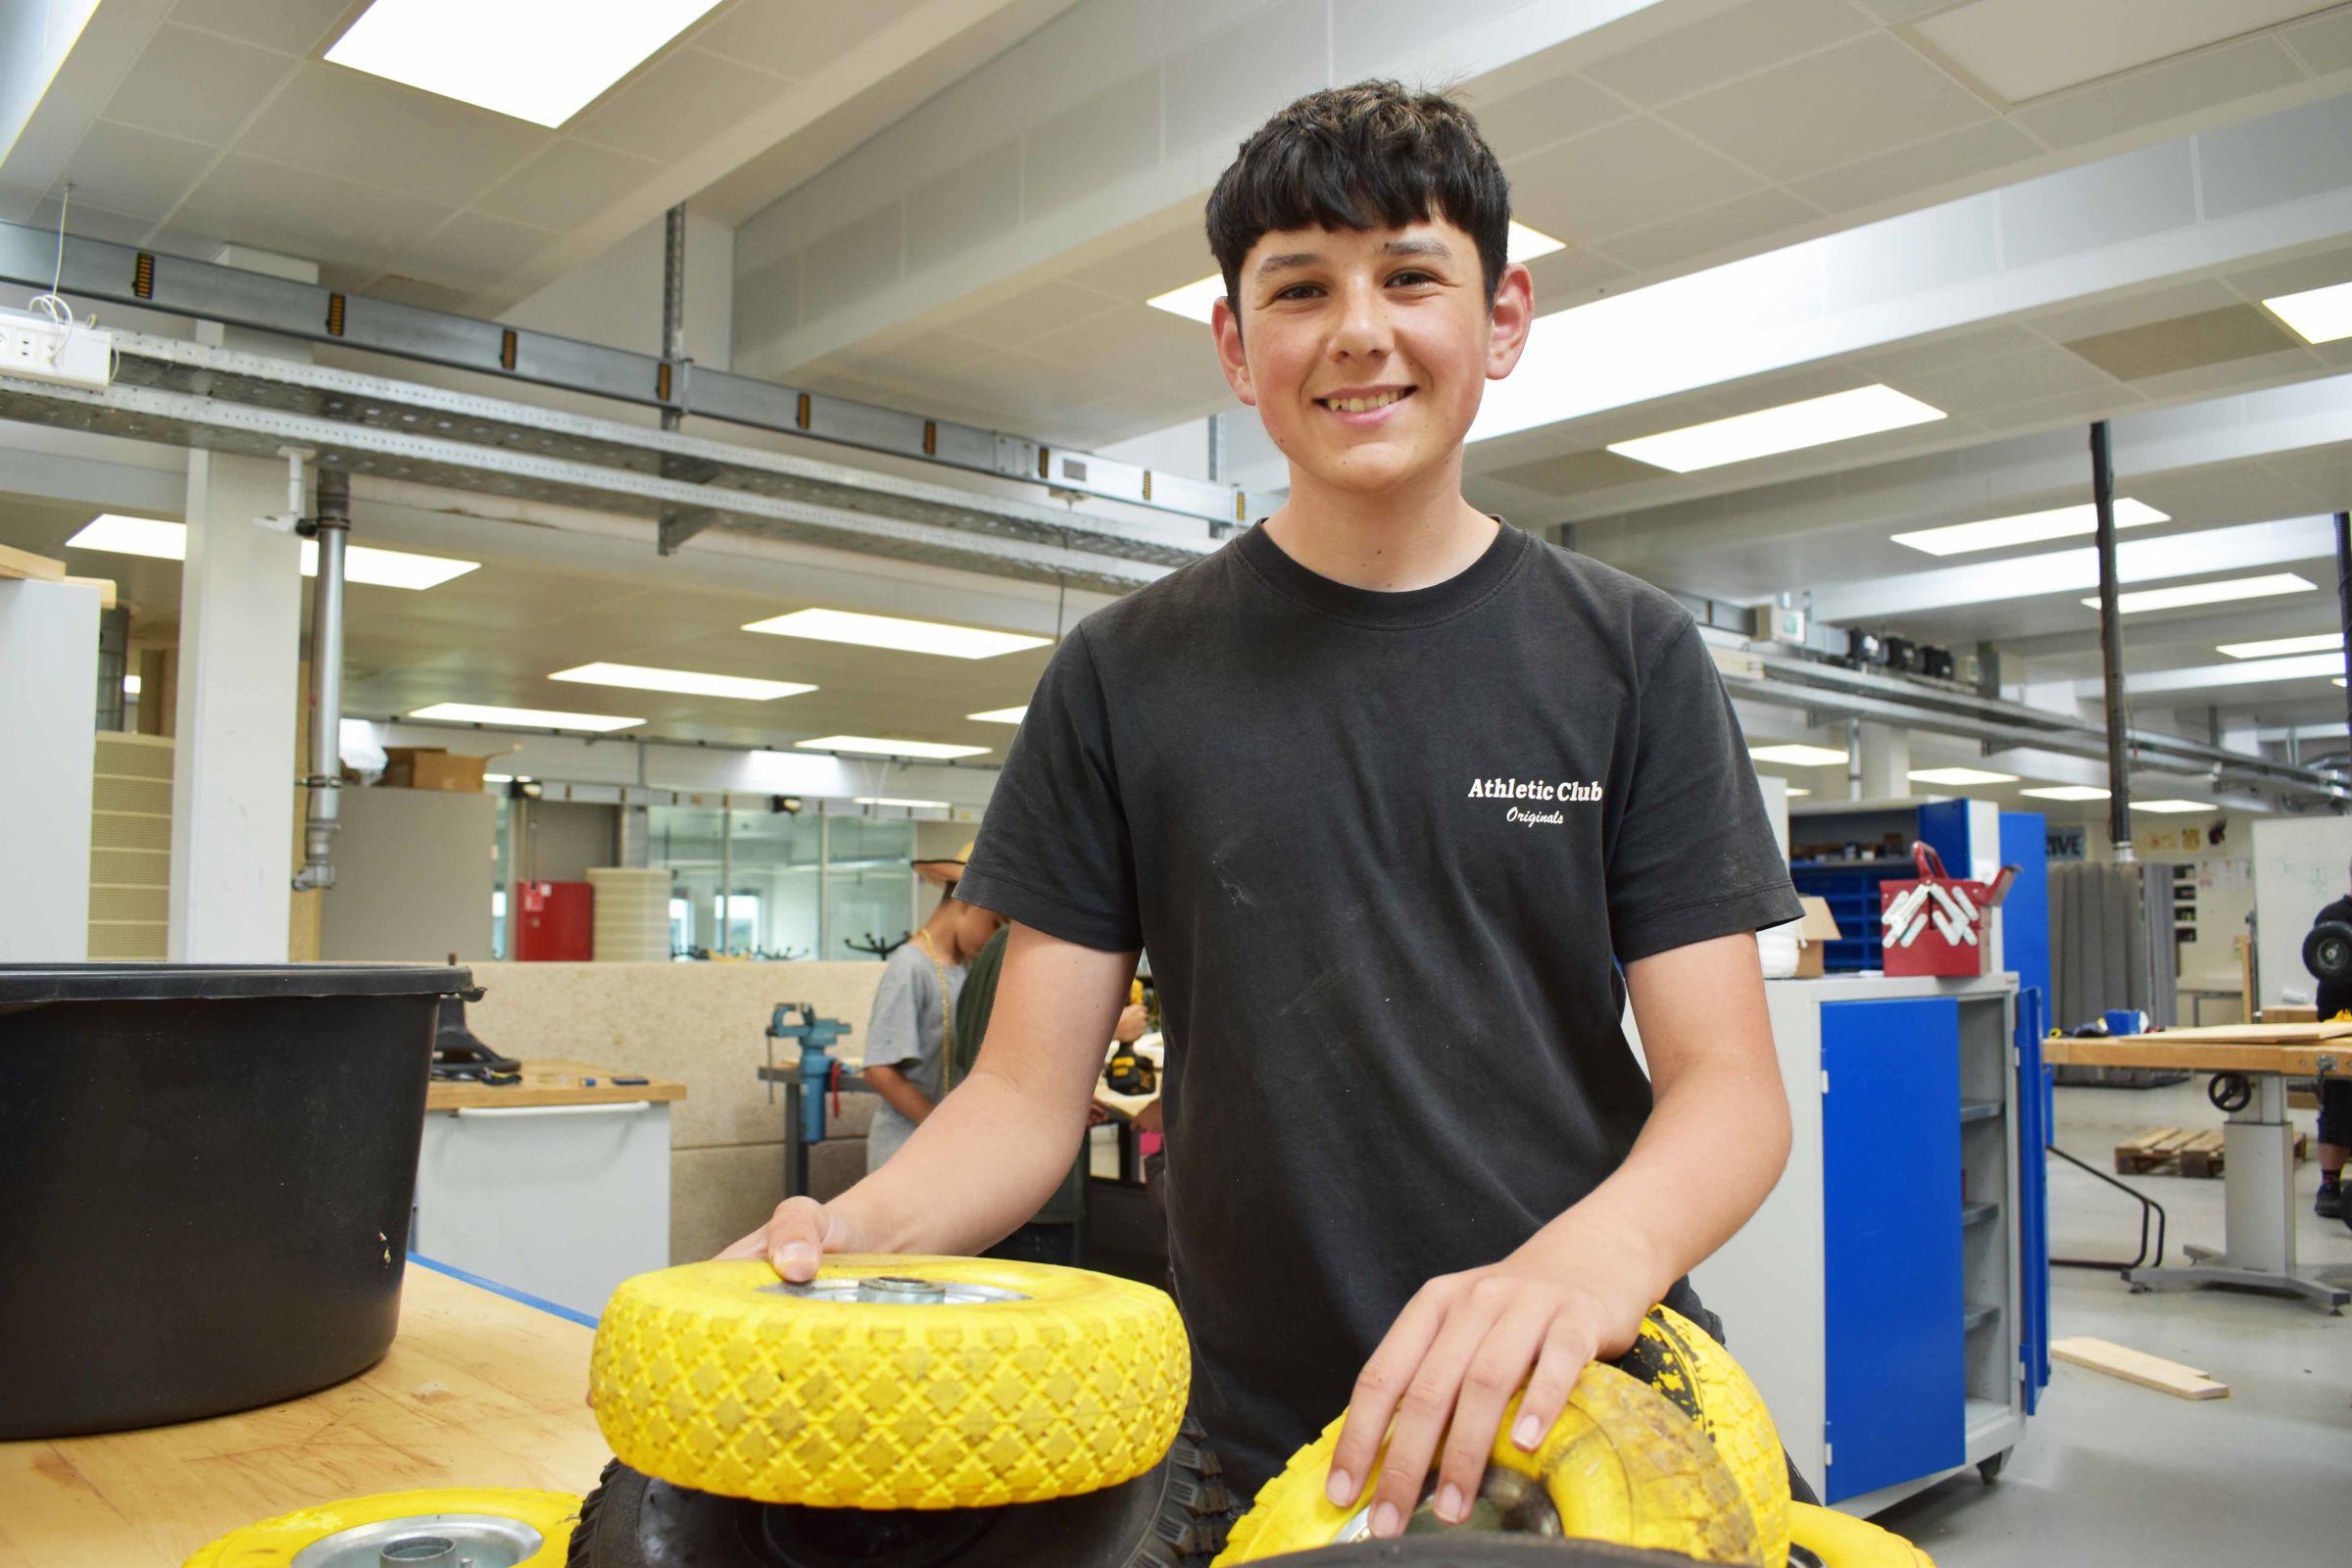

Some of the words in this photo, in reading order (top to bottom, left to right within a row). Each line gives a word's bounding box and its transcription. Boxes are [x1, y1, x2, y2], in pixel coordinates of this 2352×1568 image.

[1468, 778, 1553, 801] Athletic
[1556, 781, 1602, 802] Club
[1506, 807, 1564, 827] Originals
